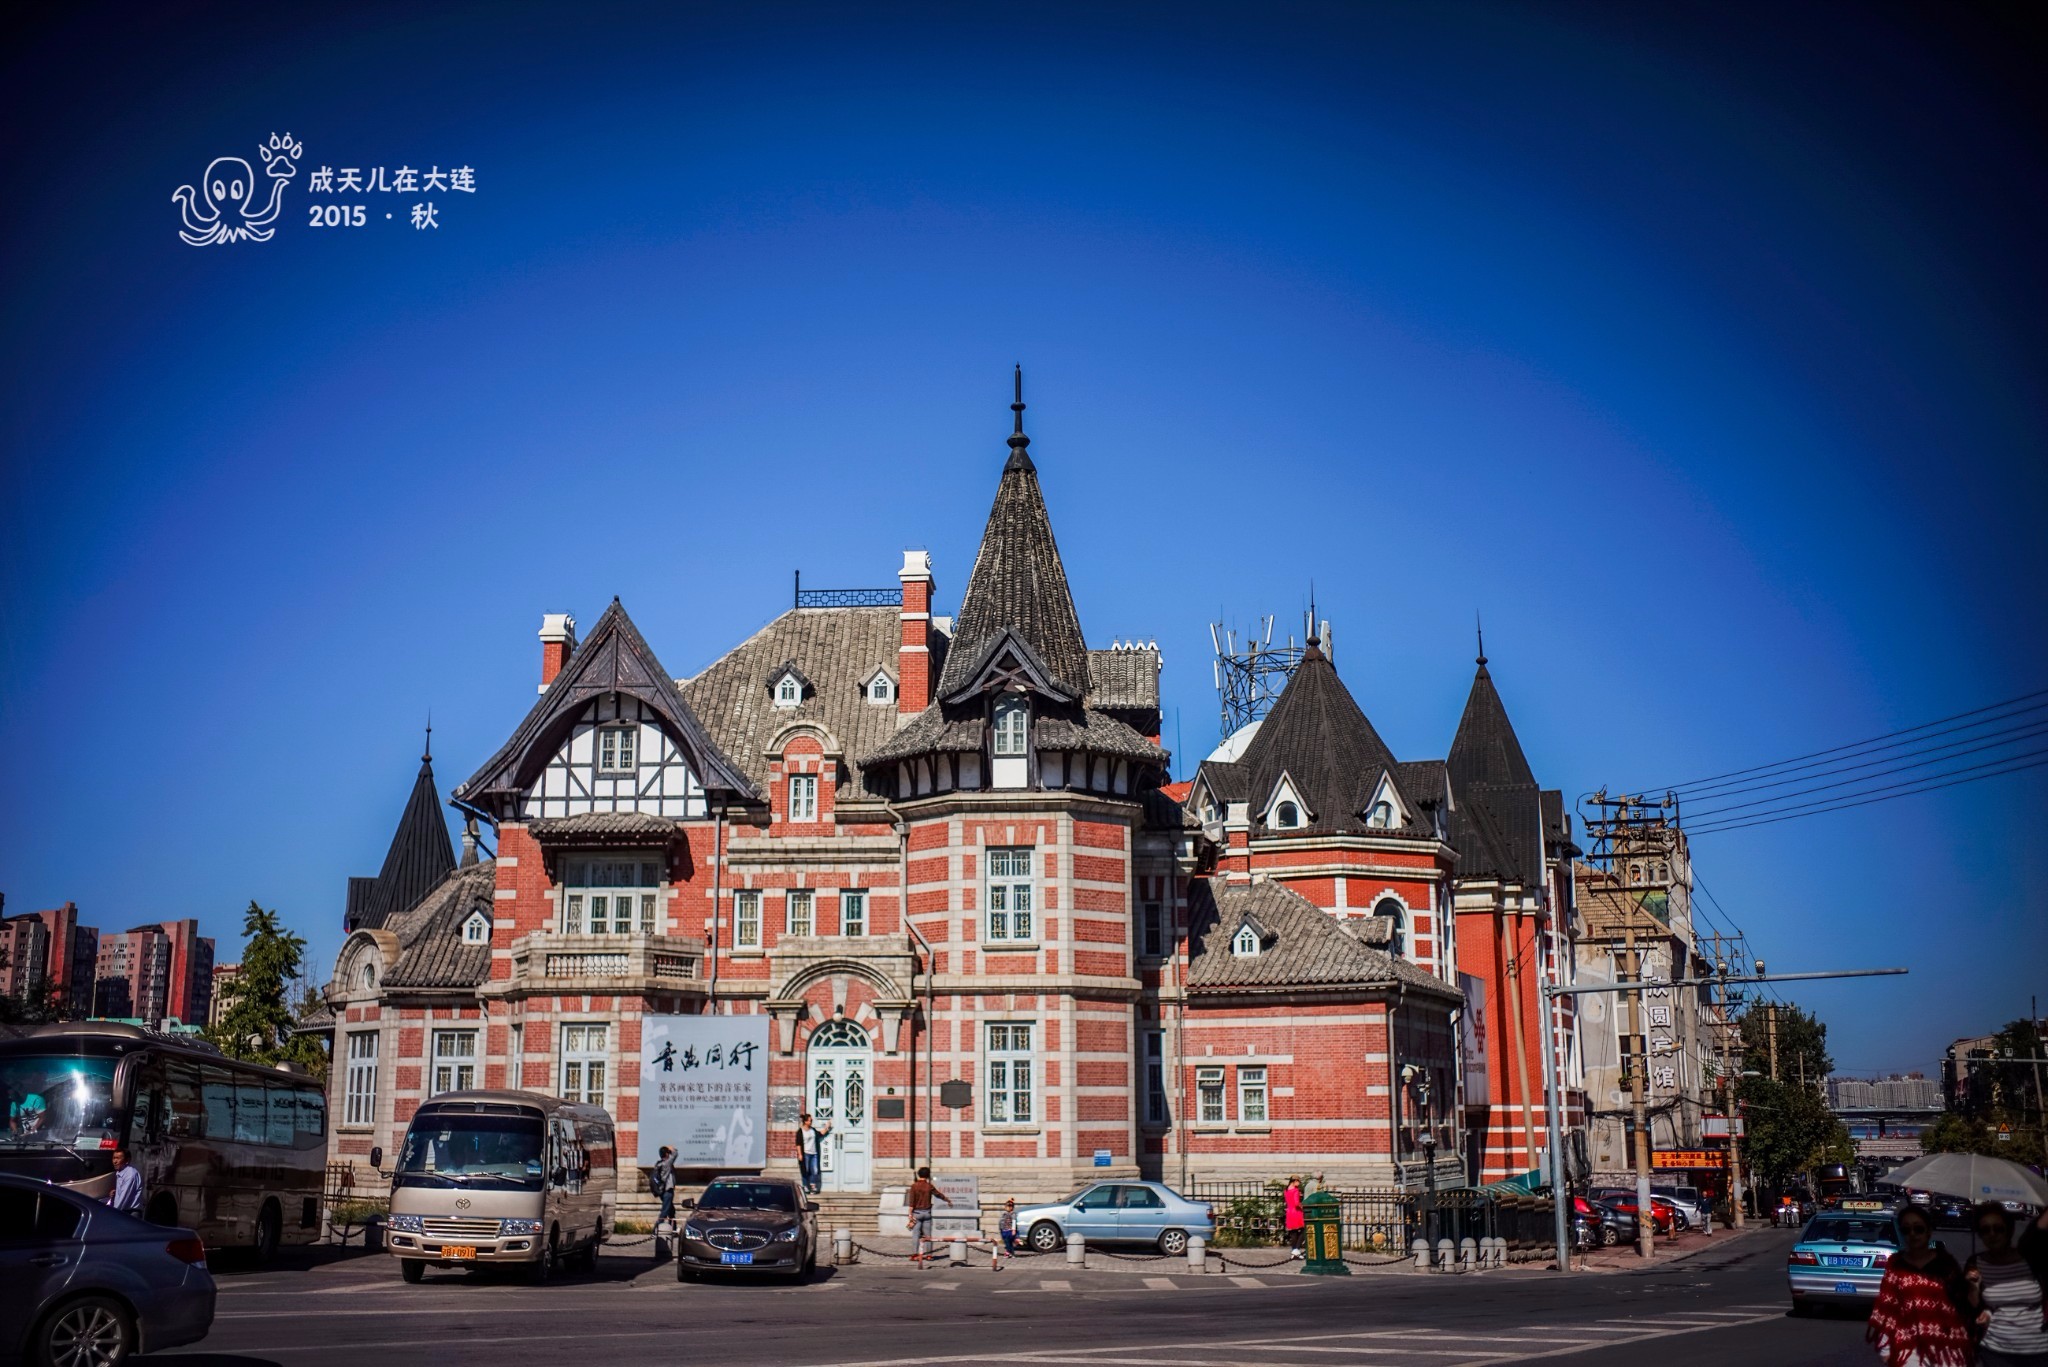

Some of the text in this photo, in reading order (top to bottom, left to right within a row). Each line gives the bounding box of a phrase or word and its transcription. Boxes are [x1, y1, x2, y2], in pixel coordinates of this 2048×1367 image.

[659, 1081, 752, 1093] 著名画家笔下的音乐家
